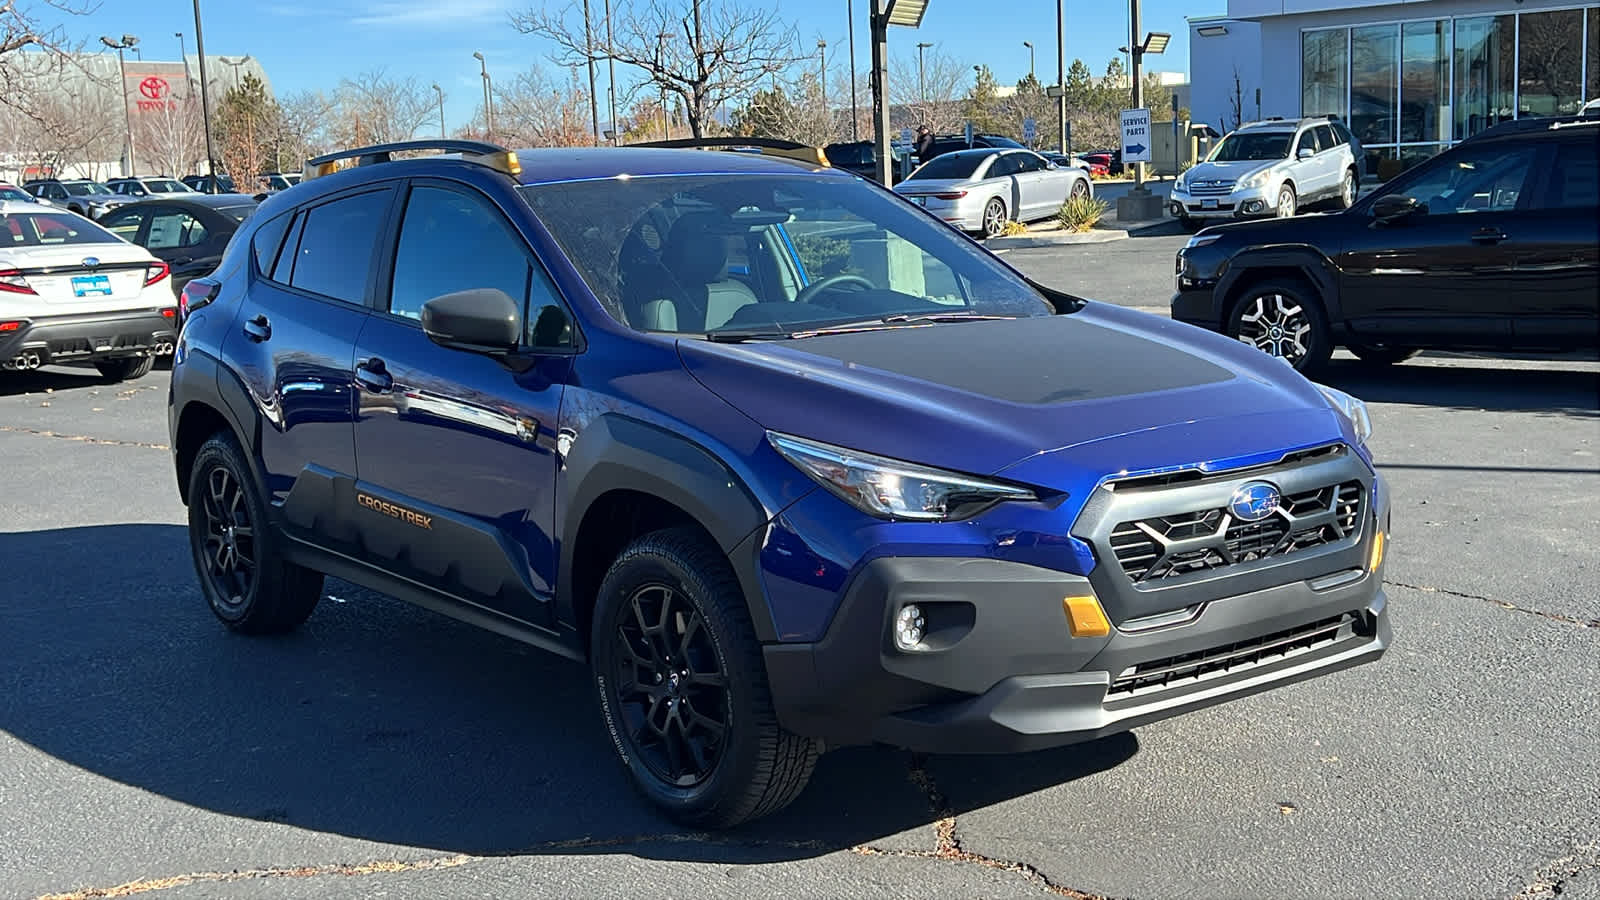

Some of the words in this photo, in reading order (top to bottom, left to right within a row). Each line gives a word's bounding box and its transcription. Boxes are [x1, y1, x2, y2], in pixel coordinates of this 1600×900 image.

[1123, 117, 1147, 127] SERVICE
[1126, 128, 1145, 136] PARTS
[357, 493, 433, 530] CROSSTREK
